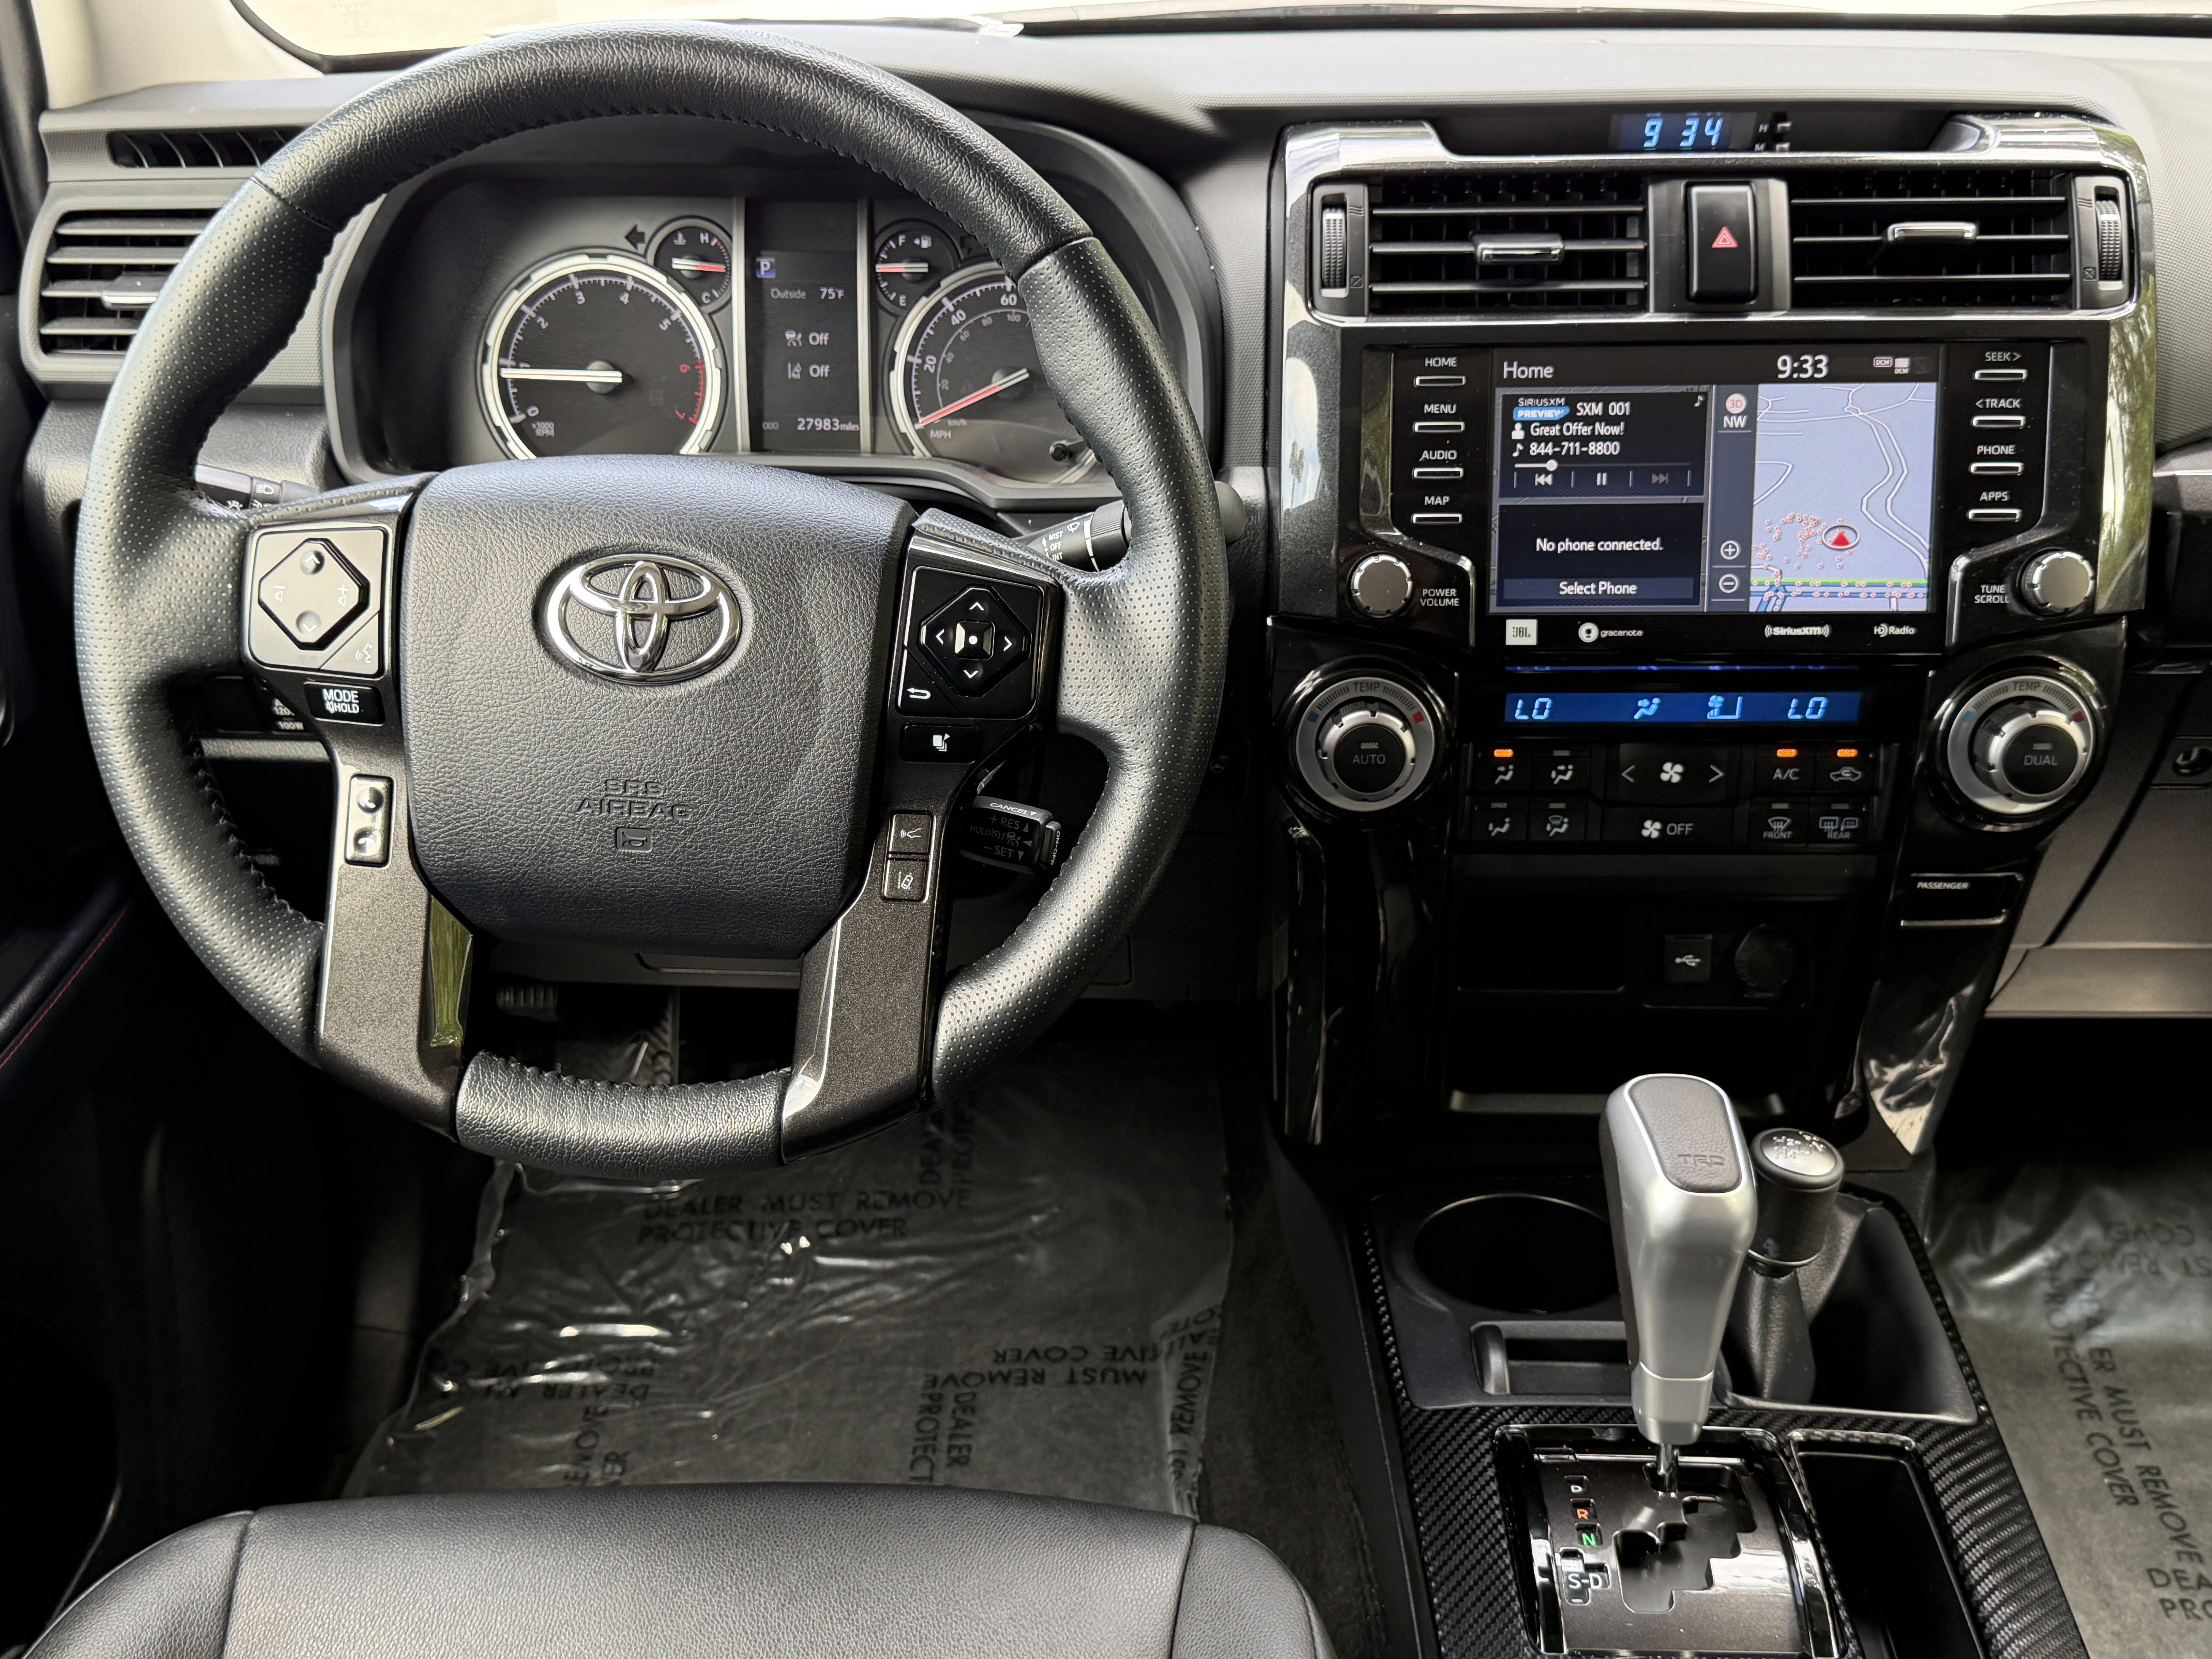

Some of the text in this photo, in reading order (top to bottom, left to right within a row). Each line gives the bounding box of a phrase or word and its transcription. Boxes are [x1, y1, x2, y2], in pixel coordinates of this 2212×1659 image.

[1644, 118, 1723, 147] 9 34
[700, 233, 709, 244] H
[898, 235, 906, 246] F
[760, 260, 771, 276] P
[576, 290, 586, 304] 3
[620, 292, 630, 304] 4
[701, 293, 710, 304] C
[770, 287, 807, 299] Outside
[899, 295, 907, 306] E
[1000, 293, 1018, 306] 60
[537, 317, 548, 329] 2
[950, 311, 967, 326] 40
[659, 319, 671, 331] 5
[809, 331, 830, 346] Off
[924, 355, 937, 373] 20
[1424, 357, 1458, 368] HOME
[1777, 354, 1830, 379] 9:33
[809, 364, 830, 378] Off
[1503, 360, 1554, 379] Home
[1424, 404, 1457, 414] MENU
[1576, 401, 1631, 416] SXM 001
[1729, 399, 1743, 409] 3D
[1984, 398, 2021, 409] TRACK
[526, 406, 539, 417] 0
[1517, 409, 1564, 419] PREVIEW
[796, 417, 840, 431] 27983
[1723, 416, 1748, 428] NW
[930, 429, 952, 439] MPH
[1530, 421, 1625, 436] Great Offer Now!
[1529, 440, 1621, 456] 844-711-8800
[1977, 445, 2016, 455] PHONE
[1421, 450, 1458, 461] AUDIO
[1424, 496, 1450, 505] MAP
[1980, 491, 2010, 502] APPS
[1049, 531, 1063, 541] MIST
[1050, 541, 1062, 551] OFF
[1536, 537, 1664, 554] No phone connected.
[1052, 551, 1063, 561] INT
[1422, 588, 1456, 597] POWER
[1559, 580, 1638, 595] Select Phone
[1980, 585, 2006, 594] TUNE
[1420, 598, 1460, 607] VOLUME
[1974, 594, 2010, 604] SCROLL
[1512, 626, 1531, 638] JBL
[1600, 629, 1644, 638] gracenote
[1888, 625, 1917, 635] Radio
[1353, 682, 1380, 692] TEMP
[2013, 681, 2042, 692] TEMP
[322, 688, 359, 703] MODE
[334, 702, 360, 713] HOLD
[1352, 754, 1386, 765] AUTO
[2023, 755, 2058, 766] DUAL
[1773, 768, 1800, 780] A/C
[605, 779, 664, 797] SRS
[579, 798, 694, 820] AIRBAG
[990, 802, 1029, 815] CANCEL
[1000, 817, 1020, 830] RES
[1666, 823, 1694, 836] OFF
[970, 825, 991, 836] HOLD
[994, 846, 1014, 858] SET
[1917, 881, 1970, 890] PASSENGER
[814, 1216, 906, 1238] COVER
[993, 1345, 1089, 1364] COVER
[1064, 1368, 1146, 1386] MUST
[1170, 1350, 1209, 1436] REMOVE
[945, 1392, 977, 1468] DEALER
[2087, 1432, 2139, 1507] COVER
[2103, 1385, 2203, 1565] MUST REMOVE
[1577, 1509, 1589, 1520] R
[1582, 1533, 1596, 1547] N
